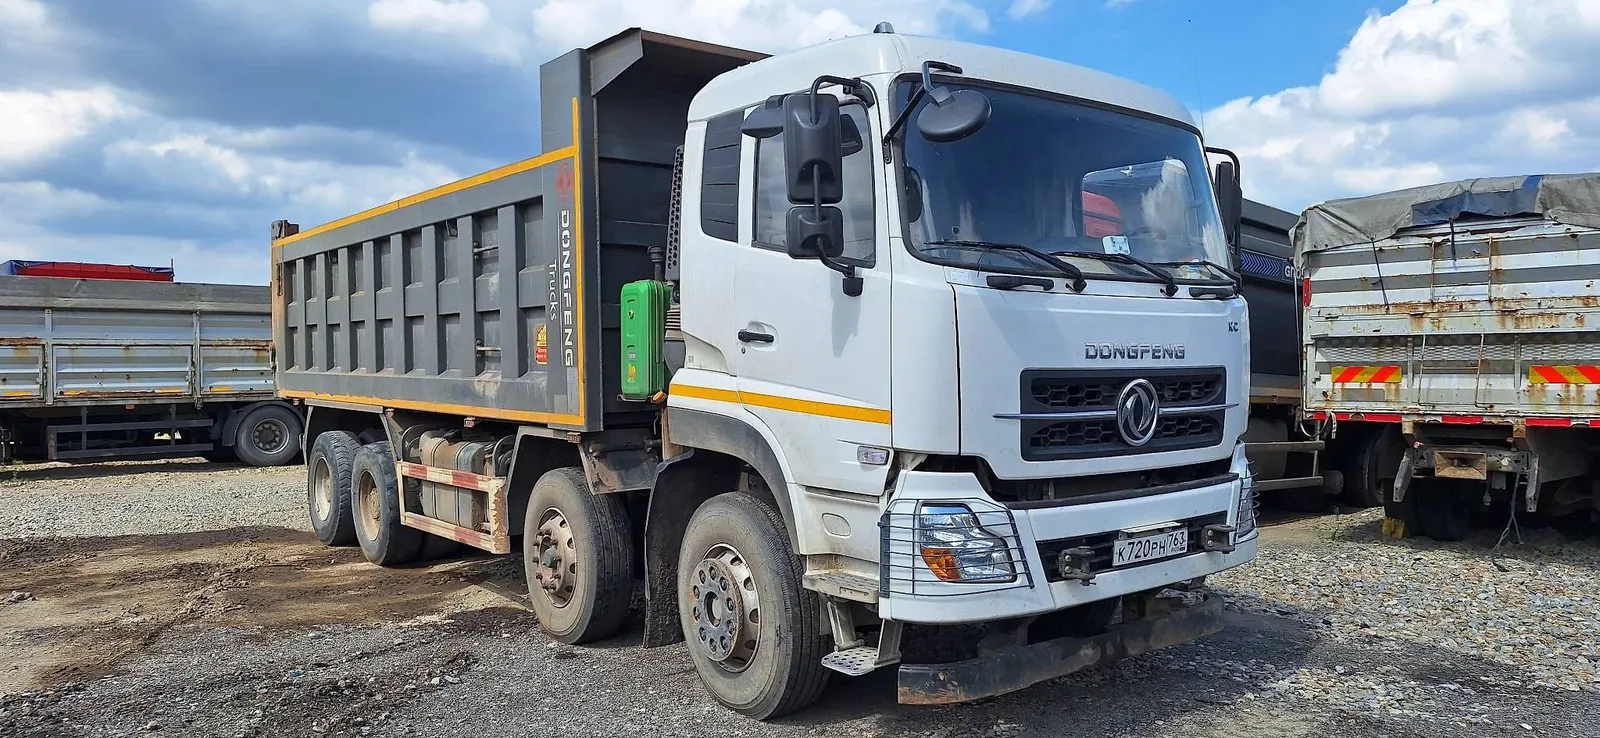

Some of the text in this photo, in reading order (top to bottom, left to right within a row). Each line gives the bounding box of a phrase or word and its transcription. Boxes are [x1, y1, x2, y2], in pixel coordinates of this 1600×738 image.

[549, 259, 557, 320] Trucks
[561, 209, 574, 367] DONGFENG
[1228, 321, 1239, 333] KC
[1084, 343, 1186, 360] DONGFENG
[1168, 531, 1185, 548] 763
